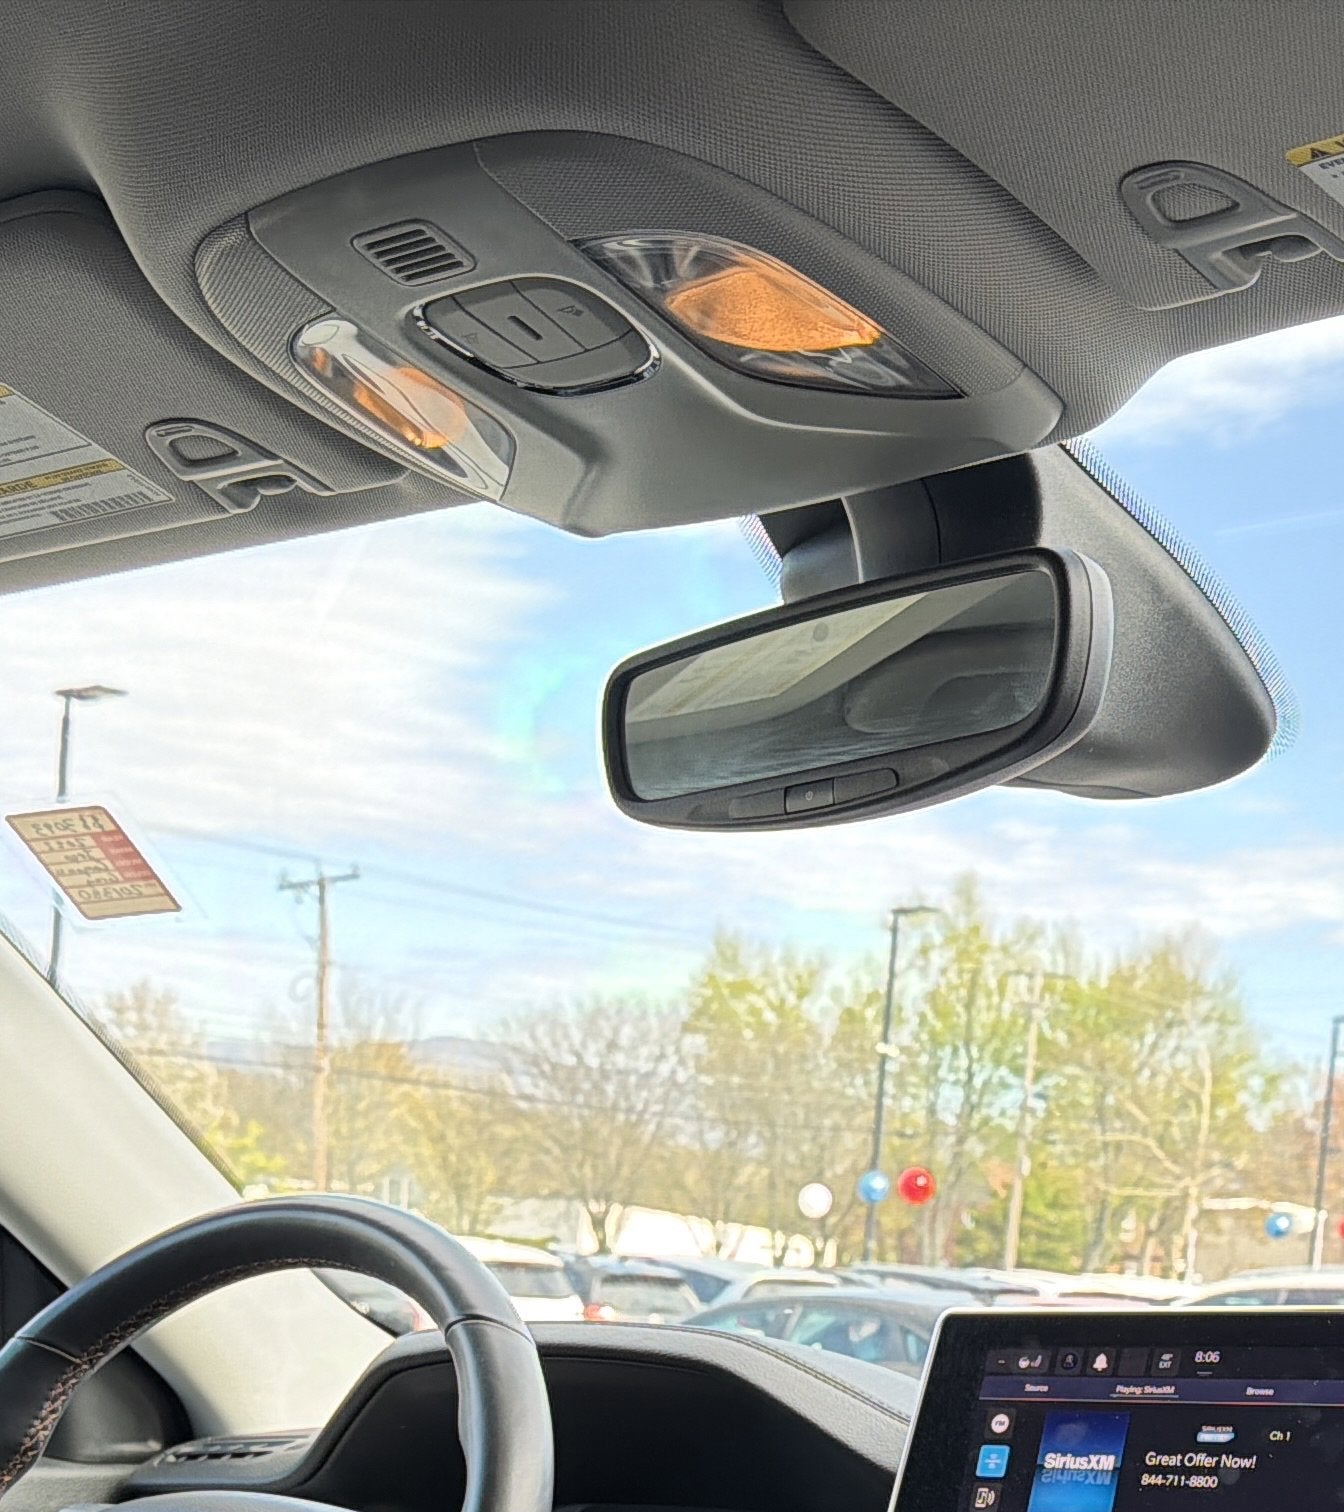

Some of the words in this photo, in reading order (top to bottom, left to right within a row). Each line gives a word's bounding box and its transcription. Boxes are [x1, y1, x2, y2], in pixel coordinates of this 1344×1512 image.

[1195, 1351, 1220, 1363] 8:06
[1024, 1384, 1048, 1392] Source
[1116, 1385, 1142, 1395] Playing:
[1144, 1385, 1175, 1394] SiriusXM
[1246, 1387, 1274, 1396] Browse
[1269, 1431, 1284, 1441] Ch
[1044, 1452, 1116, 1471] SiriusXM
[1145, 1452, 1181, 1467] Great
[1184, 1452, 1218, 1468] Offer
[1220, 1454, 1257, 1469] Now!
[1141, 1473, 1218, 1489] 844-711-8800
